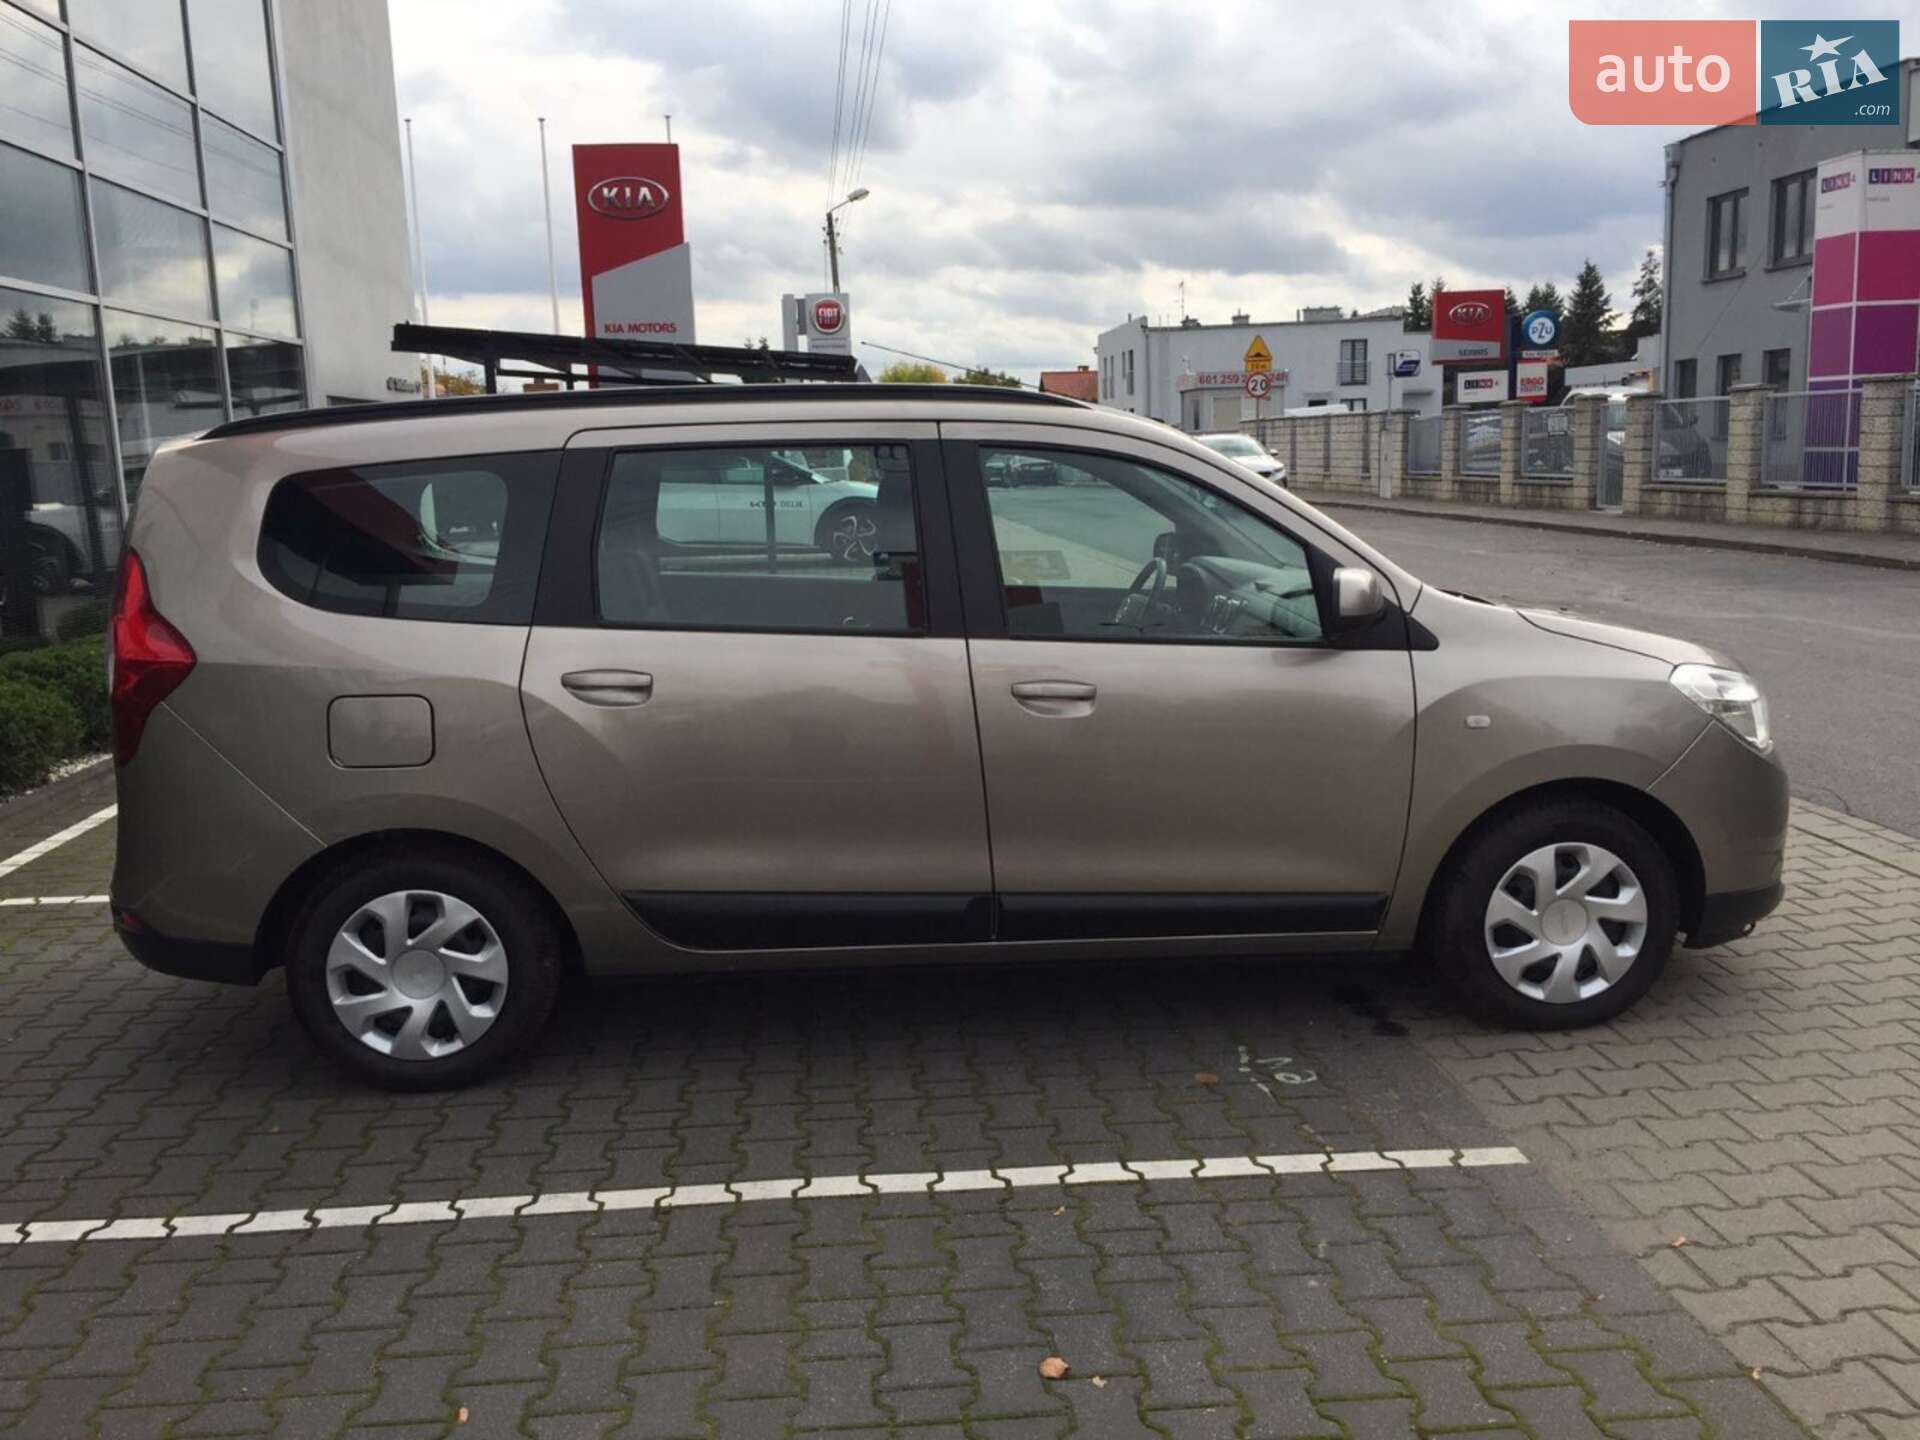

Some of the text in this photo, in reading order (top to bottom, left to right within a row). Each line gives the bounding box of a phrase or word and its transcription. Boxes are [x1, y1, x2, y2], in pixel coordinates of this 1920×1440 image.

[602, 186, 656, 209] KIA
[818, 308, 838, 325] FIAT
[1456, 307, 1485, 320] KIA
[604, 322, 677, 334] KIA MOTORS
[1251, 378, 1267, 392] 20
